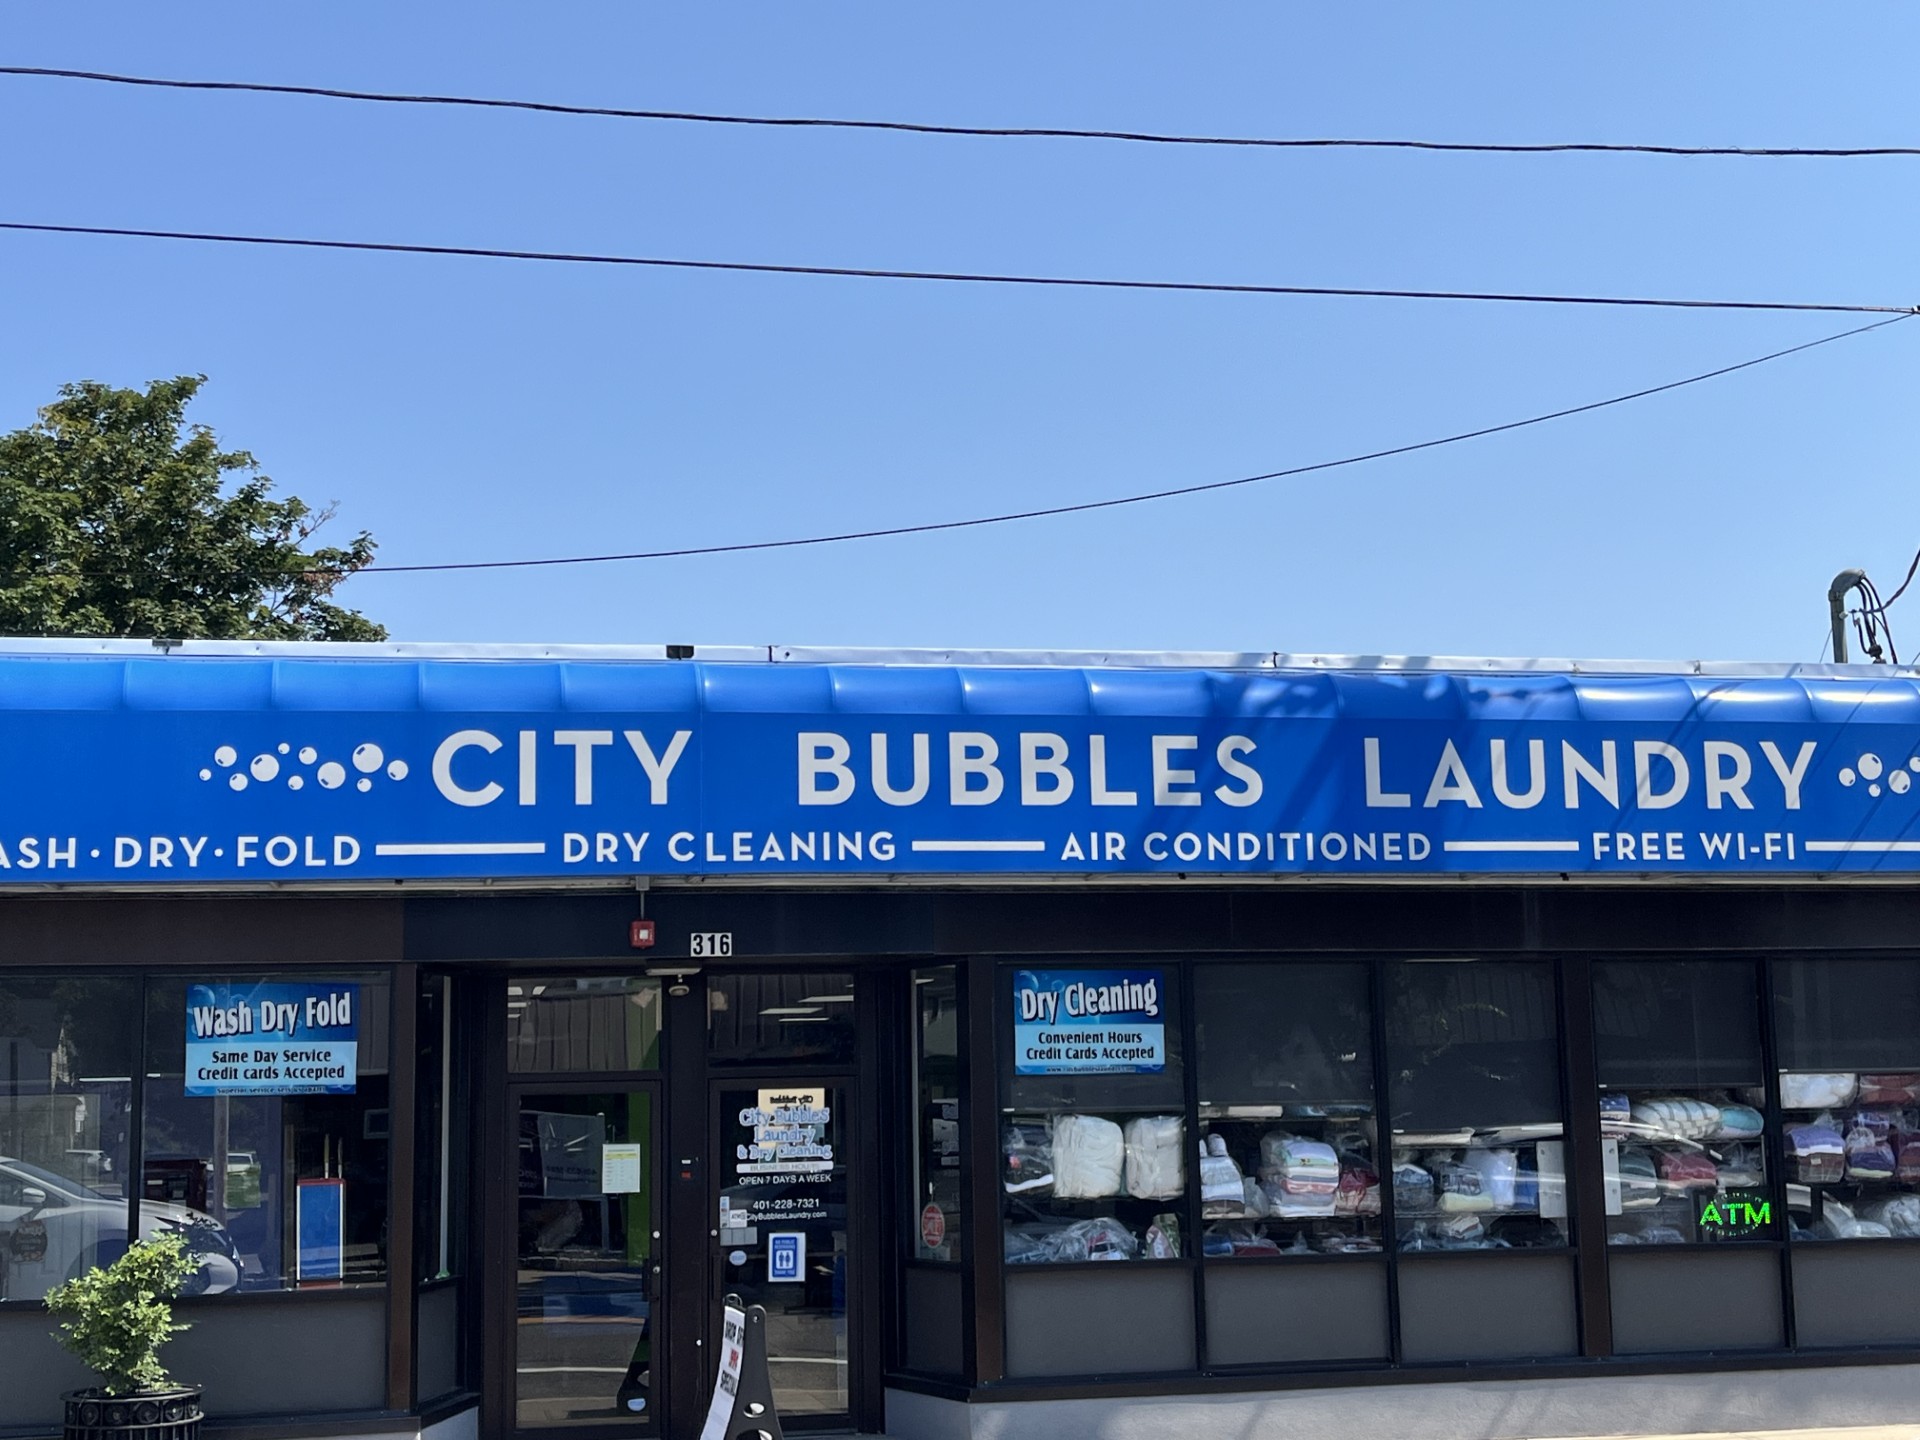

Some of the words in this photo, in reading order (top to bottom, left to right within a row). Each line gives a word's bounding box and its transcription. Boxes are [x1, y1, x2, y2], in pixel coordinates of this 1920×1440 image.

[432, 729, 693, 807] CITY
[797, 731, 1263, 807] BUBBLES
[1364, 737, 1818, 810] LAUNDRY
[114, 836, 208, 868] DRY
[237, 835, 361, 867] FOLD
[563, 832, 650, 863] DRY
[667, 831, 896, 862] CLEANING
[1060, 831, 1126, 861] AIR
[1143, 832, 1431, 861] CONDITIONED
[1592, 832, 1685, 860] FREE
[1699, 832, 1795, 860] WI-FI
[692, 934, 730, 955] 316
[1021, 988, 1058, 1024] Dry
[1065, 979, 1158, 1017] Cleaning
[193, 1001, 252, 1037] Wash
[261, 1001, 299, 1035] Dry
[306, 992, 351, 1028] Fold
[1038, 1031, 1104, 1044] Convenient
[1108, 1031, 1142, 1044] Hours
[212, 1050, 249, 1063] Same
[253, 1050, 279, 1064] Day
[283, 1049, 331, 1062] Service
[1026, 1047, 1061, 1060] Credit
[1065, 1046, 1098, 1060] Cards
[1101, 1046, 1154, 1061] Accepted
[198, 1066, 239, 1080] Credit
[243, 1066, 279, 1080] cards
[283, 1065, 345, 1081] Accepted
[739, 1107, 771, 1126] City
[775, 1106, 830, 1124] Bubbles
[753, 1125, 817, 1146] Laundry
[737, 1144, 748, 1159] &
[749, 1144, 776, 1161] Dry
[777, 1143, 833, 1160] Cleaning
[750, 1163, 790, 1172] BUSINESS
[739, 1176, 764, 1186] OPEN
[766, 1176, 771, 1184] 7
[773, 1175, 797, 1184] DAYS
[798, 1174, 806, 1183] A
[806, 1173, 832, 1183] WEEK
[752, 1198, 820, 1210] 401-228-7321
[1700, 1202, 1771, 1226] ATM
